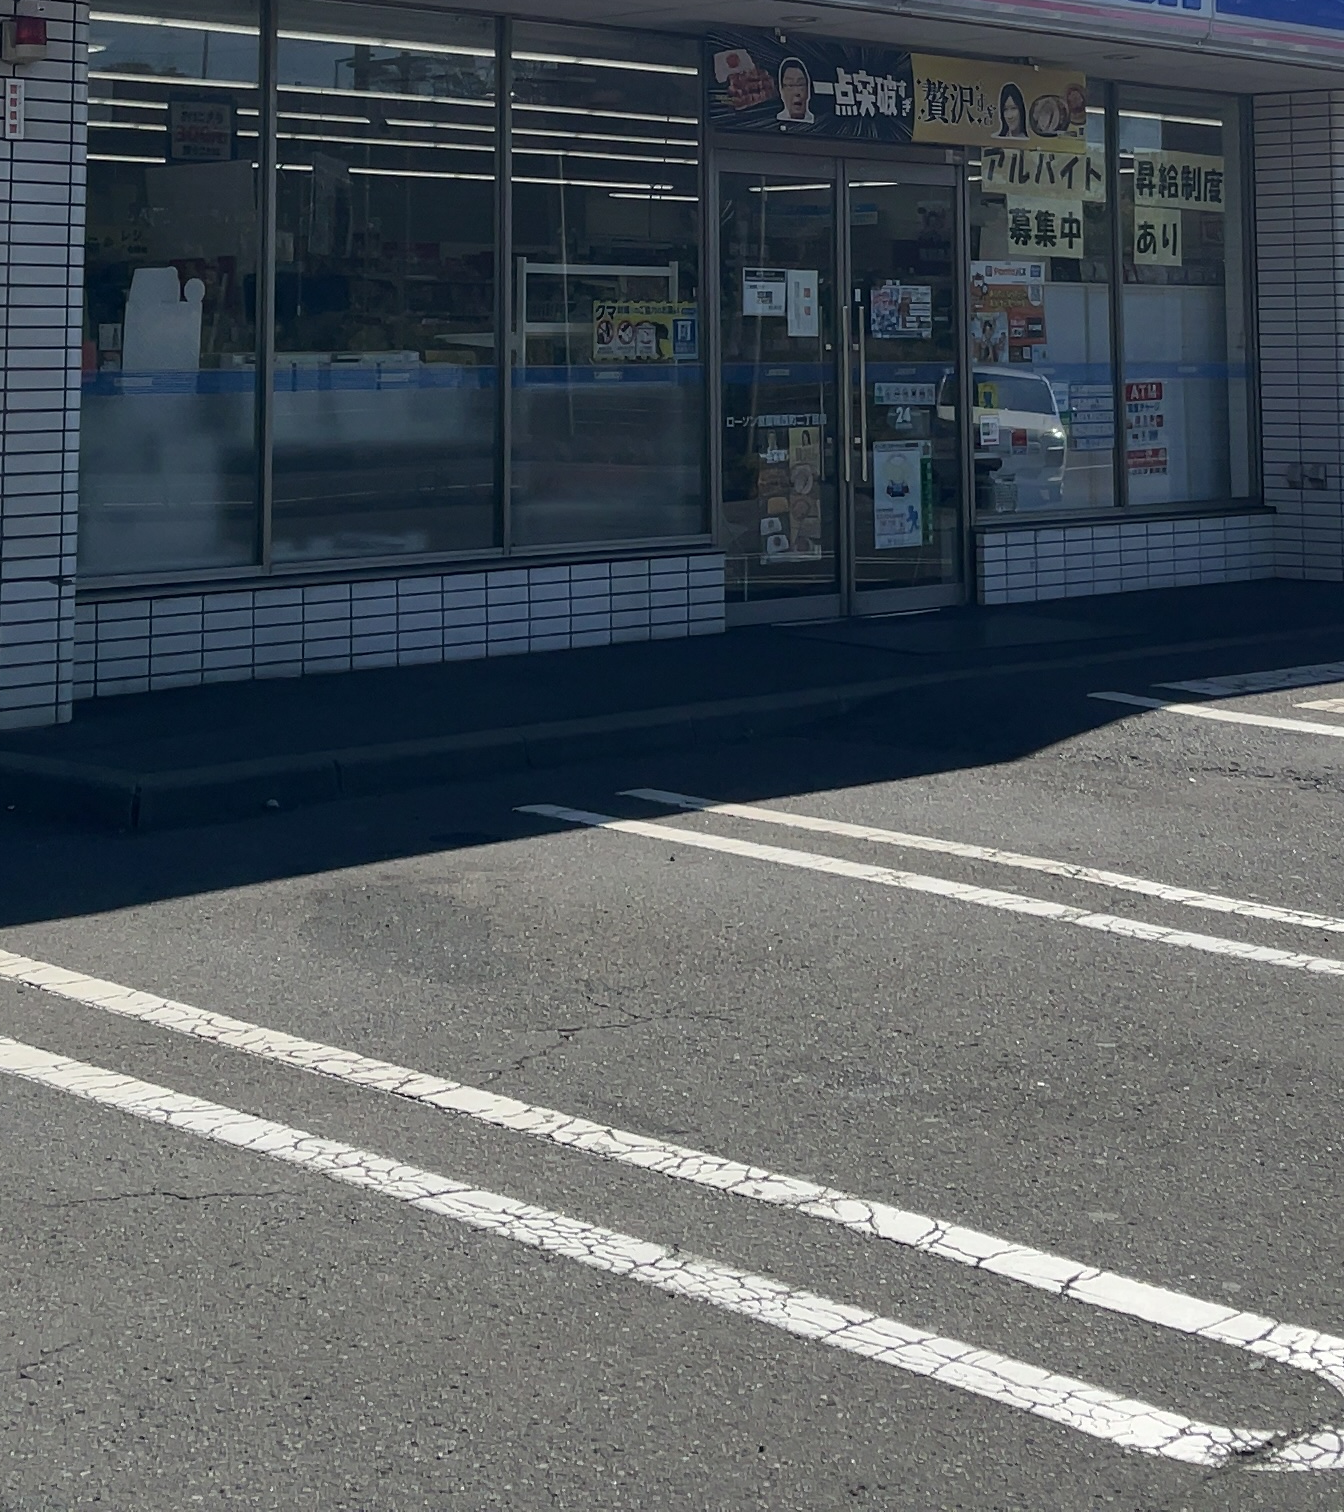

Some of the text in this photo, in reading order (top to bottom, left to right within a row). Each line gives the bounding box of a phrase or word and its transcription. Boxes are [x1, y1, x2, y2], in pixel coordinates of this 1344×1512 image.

[983, 147, 1102, 191] アルバイト
[1135, 160, 1224, 204] 昇給制度
[1008, 207, 1081, 250] 募集中
[1136, 220, 1178, 256] あり
[595, 304, 617, 321] クマ
[1130, 383, 1157, 400] ATM
